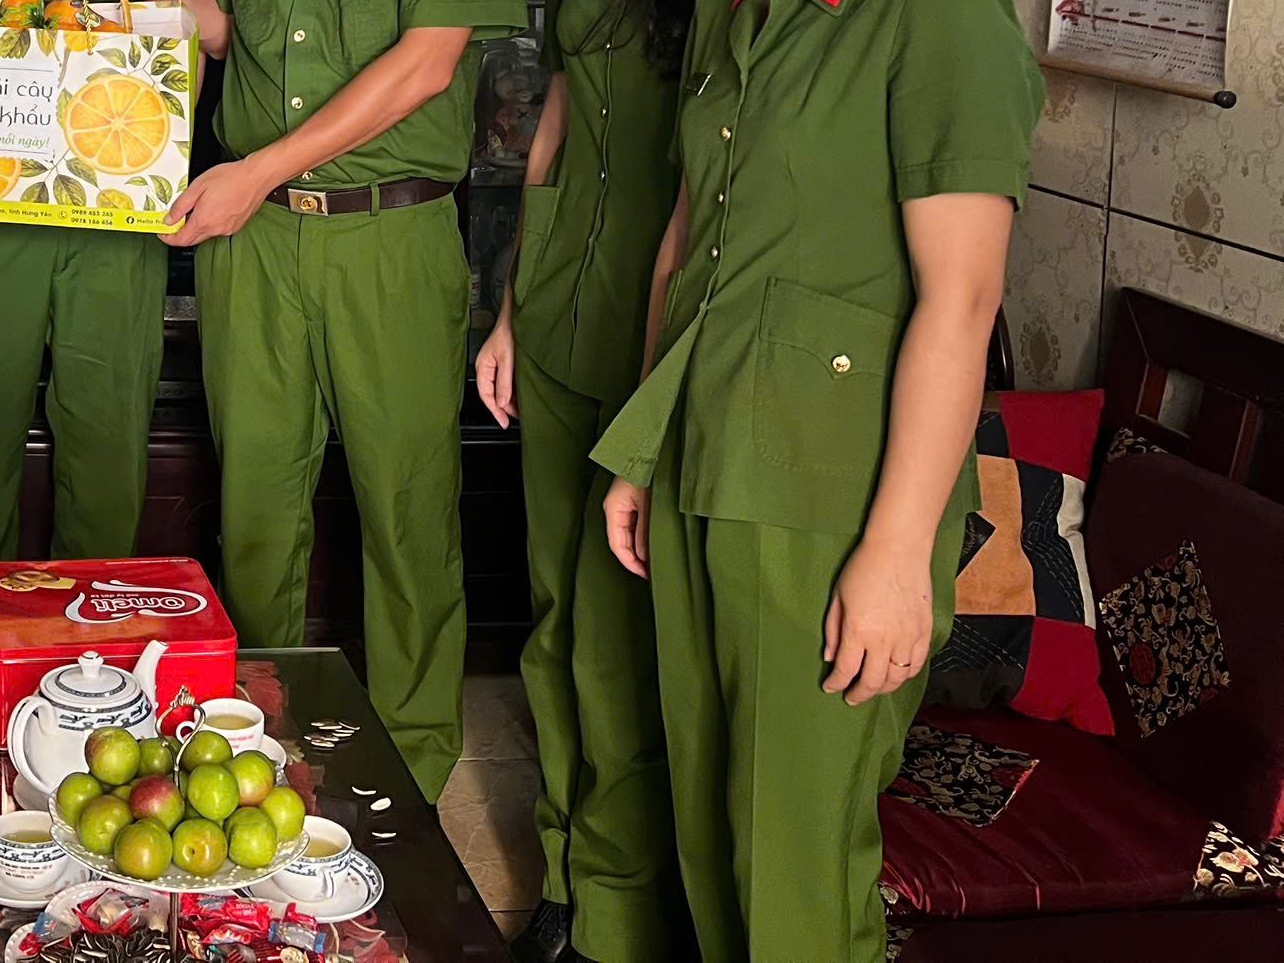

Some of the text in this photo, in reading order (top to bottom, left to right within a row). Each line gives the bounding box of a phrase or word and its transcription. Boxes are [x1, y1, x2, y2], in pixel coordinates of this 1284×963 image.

[16, 80, 53, 102] cây
[0, 104, 51, 127] khẩu
[90, 597, 185, 611] Omeli
